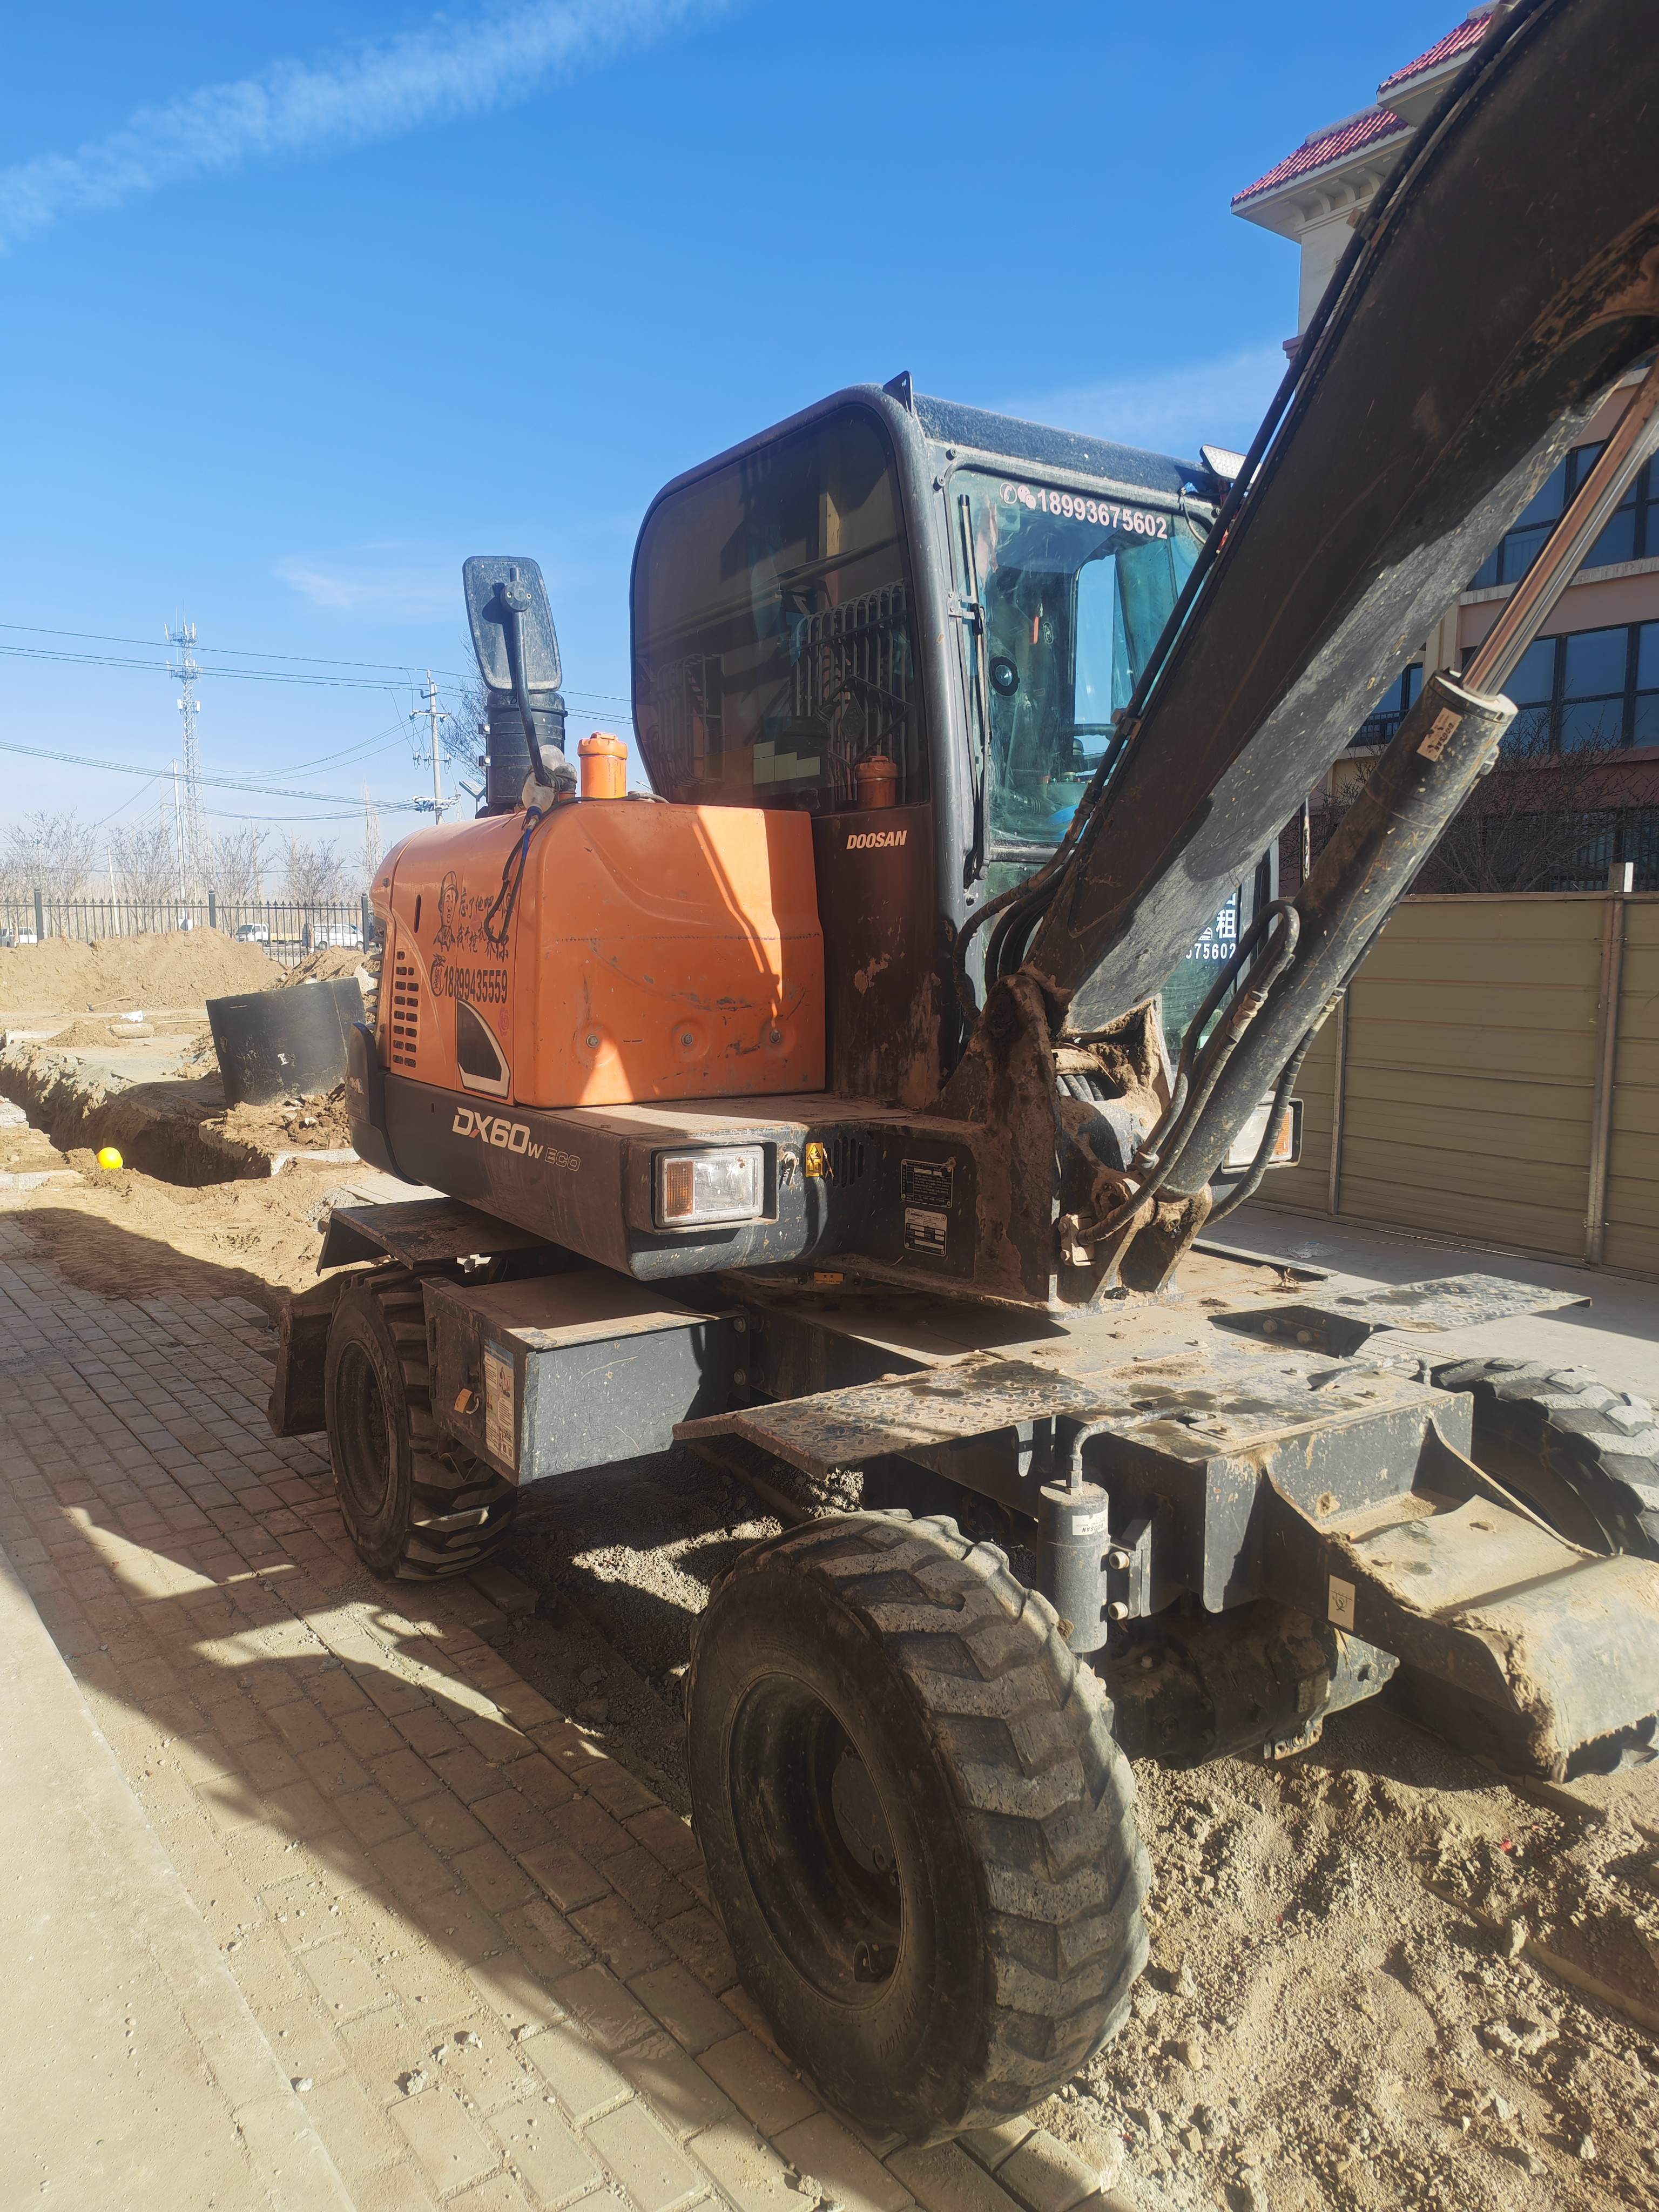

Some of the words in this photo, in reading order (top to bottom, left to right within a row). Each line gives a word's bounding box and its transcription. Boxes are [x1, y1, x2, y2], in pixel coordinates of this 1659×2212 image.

[1037, 489, 1168, 539] 18993675602
[846, 830, 907, 849] DOOSAN
[444, 966, 508, 1003] 18899435559
[544, 1147, 581, 1171] ECO
